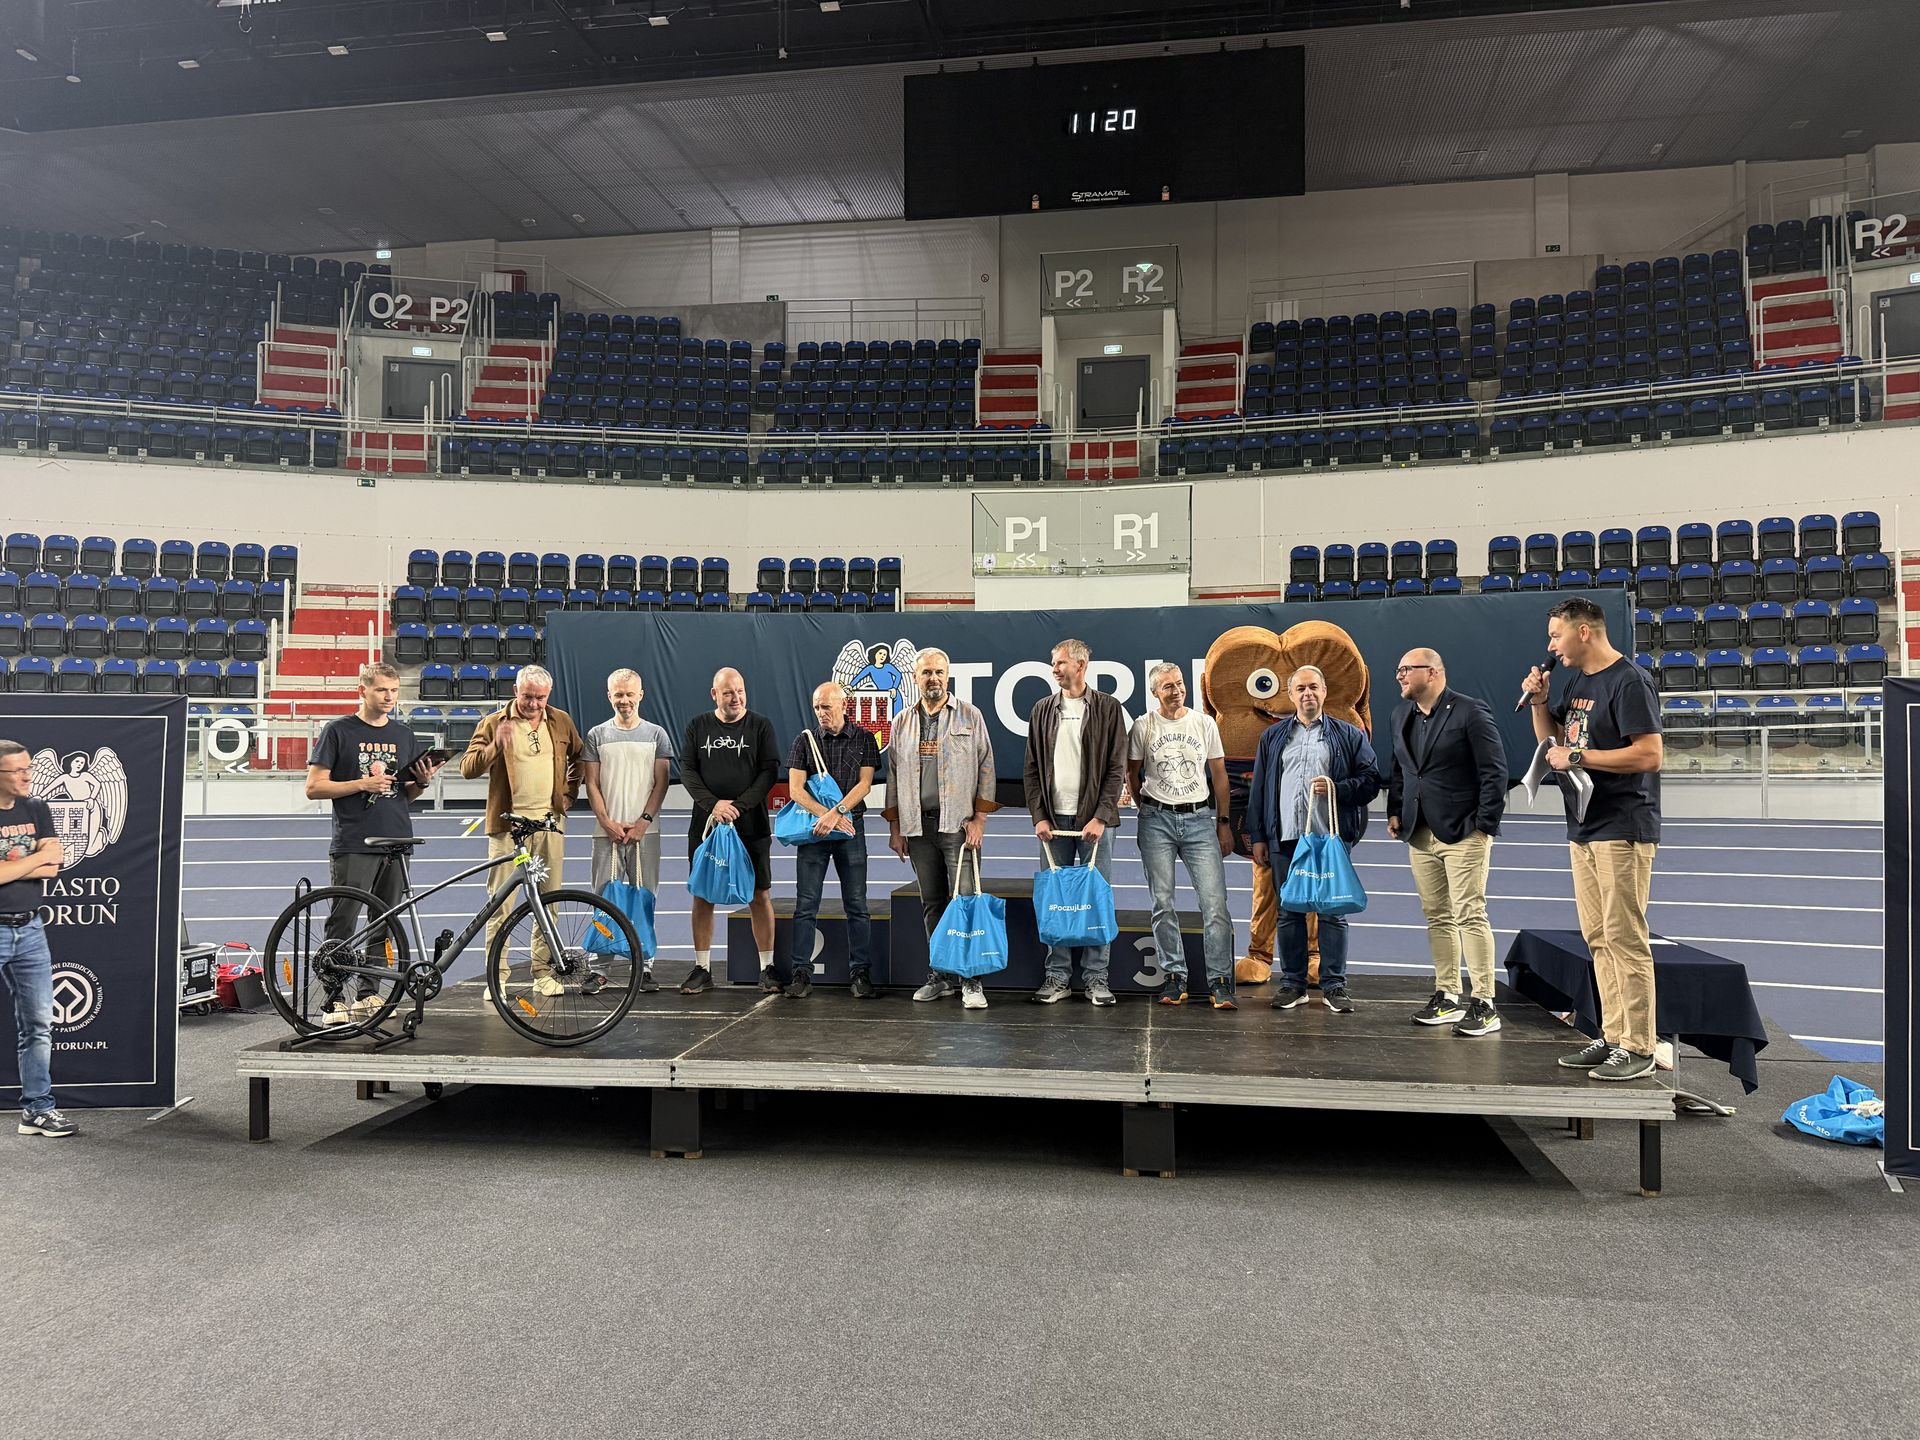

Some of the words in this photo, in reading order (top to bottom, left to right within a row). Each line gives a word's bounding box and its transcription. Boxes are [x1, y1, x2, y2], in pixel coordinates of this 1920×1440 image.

[1854, 213, 1908, 250] R2
[1055, 269, 1094, 298] P2
[1122, 264, 1164, 294] R2
[368, 292, 413, 320] O2
[430, 296, 469, 324] P2
[1005, 516, 1048, 552] P1
[1113, 512, 1159, 550] R1
[207, 718, 269, 761] O1
[1150, 733, 1187, 753] LEGENDARY
[1186, 736, 1202, 752] BIKE
[1172, 786, 1180, 796] IN
[1180, 780, 1200, 796] TOWN
[42, 877, 120, 897] IASTO
[37, 898, 119, 925] ORUŃ
[1133, 936, 1168, 987] 3
[51, 1041, 108, 1051] .TORUN.PL
